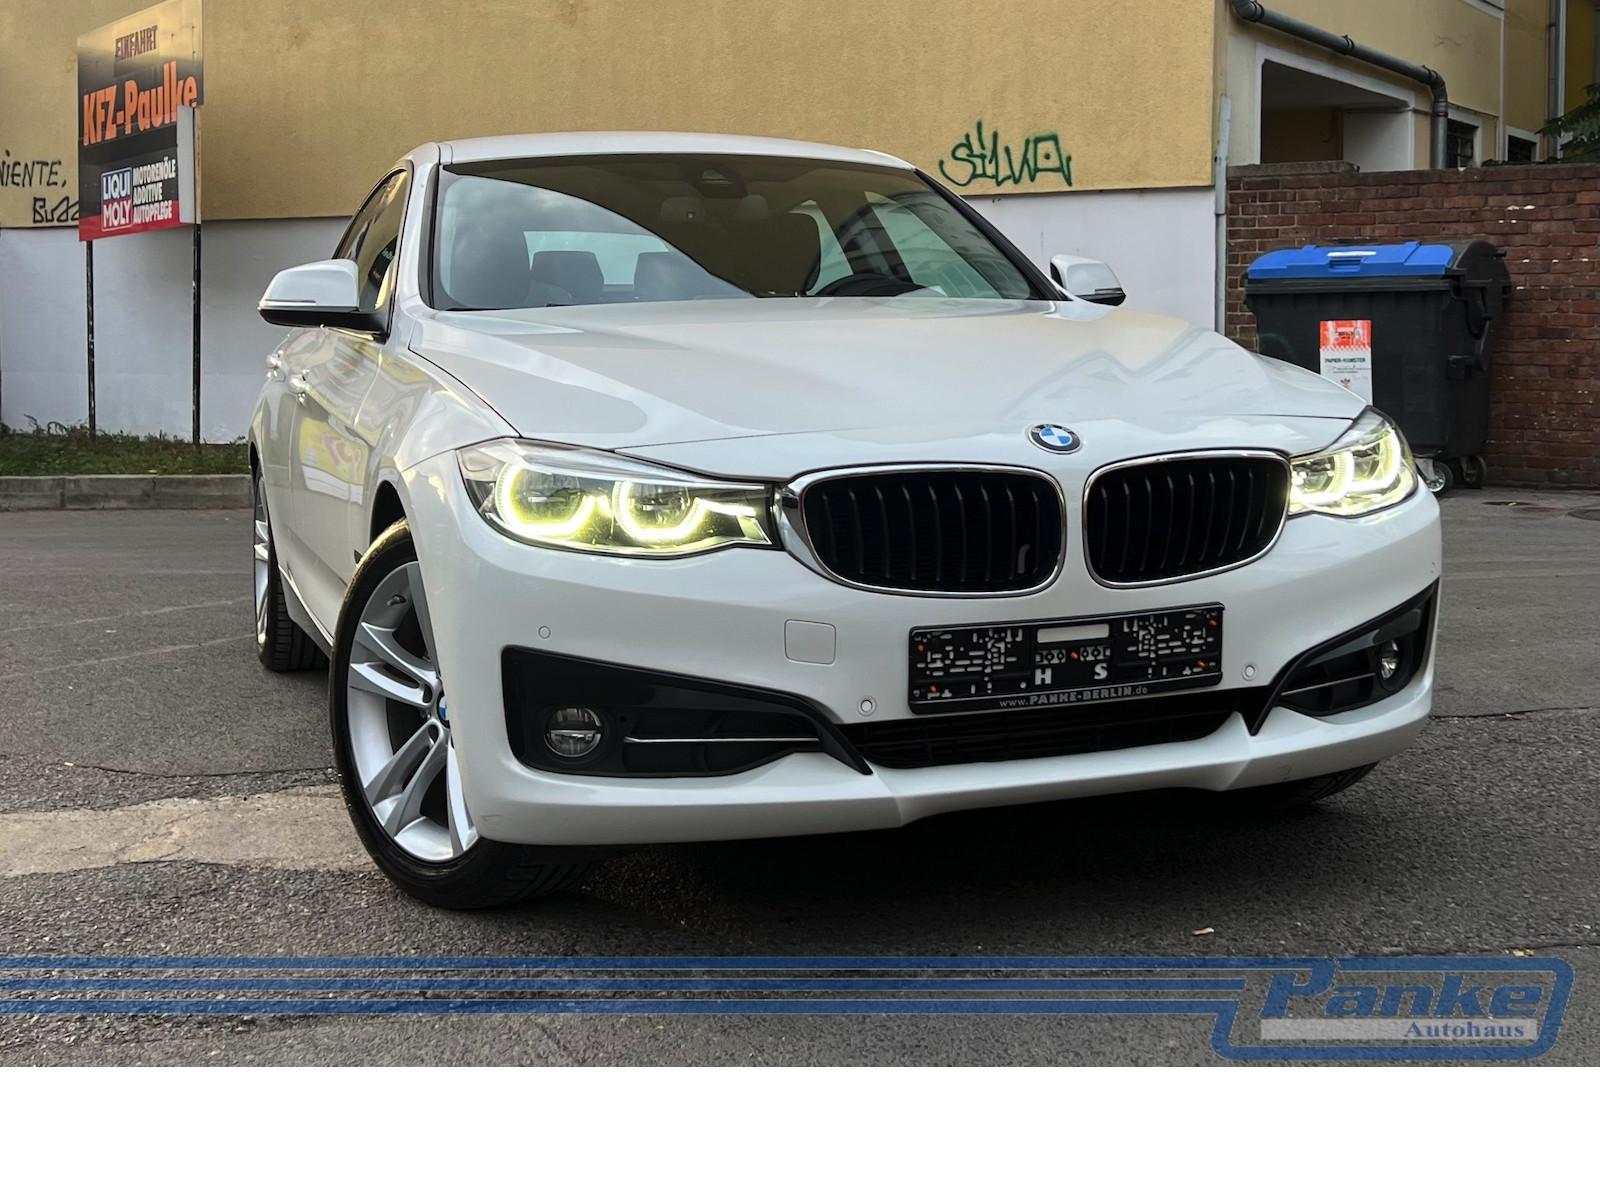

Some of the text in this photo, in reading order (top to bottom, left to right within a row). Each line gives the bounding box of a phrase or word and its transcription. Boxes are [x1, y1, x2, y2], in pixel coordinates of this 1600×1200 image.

[115, 25, 158, 60] EINFAHRT
[83, 61, 198, 146] KFZ-Paulke
[103, 171, 131, 200] LIQUI
[133, 156, 176, 187] MOTORENÖLE
[133, 182, 163, 206] ADDITIVE
[103, 199, 132, 228] MOLY
[133, 199, 173, 225] AUTOPFLEGE
[1034, 662, 1108, 686] H S
